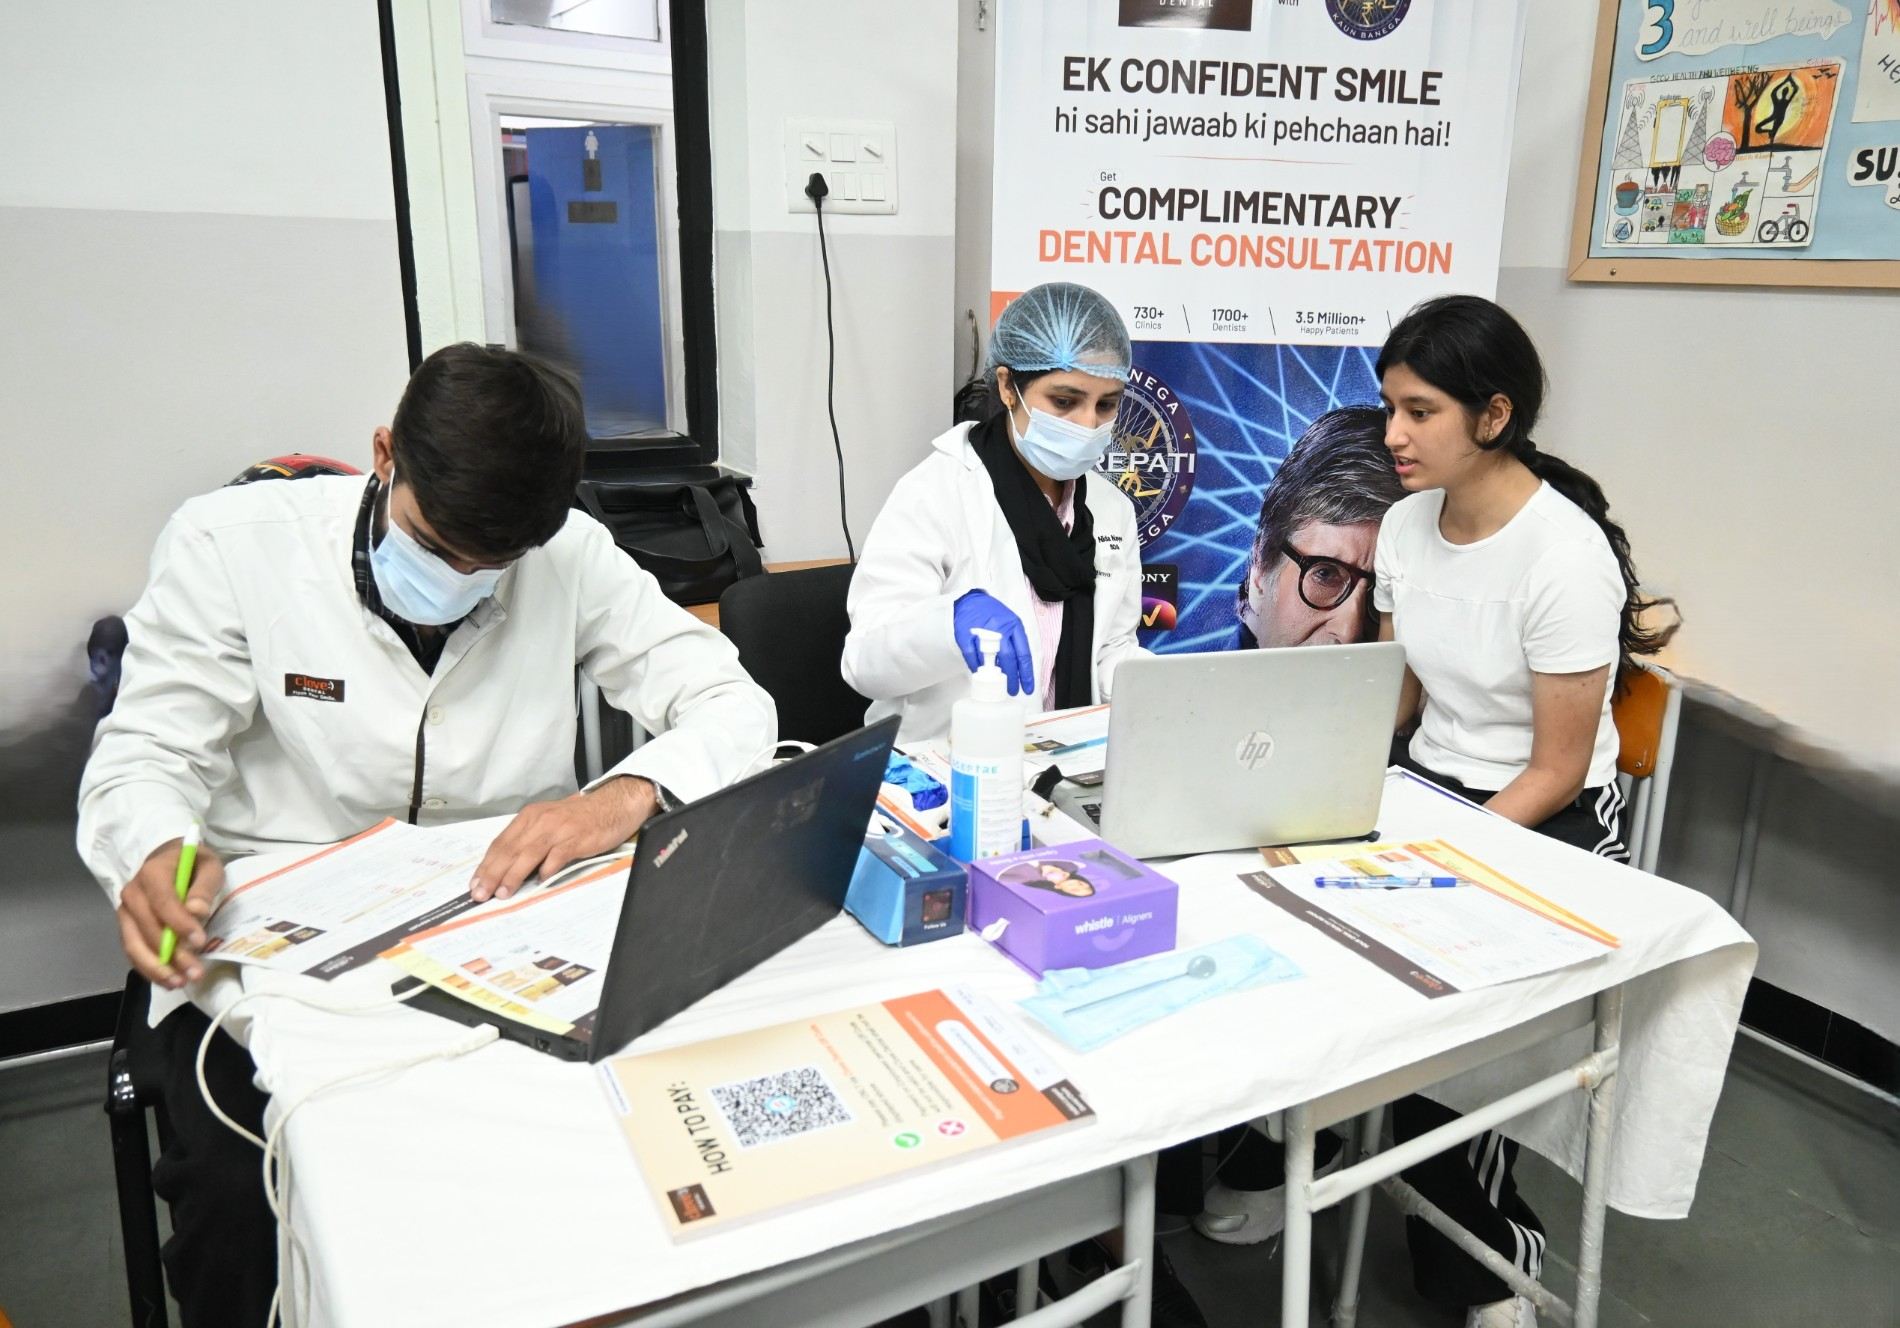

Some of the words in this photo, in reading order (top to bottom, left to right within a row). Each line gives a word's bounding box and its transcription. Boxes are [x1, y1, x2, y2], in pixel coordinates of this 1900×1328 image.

[1333, 13, 1356, 36] KAUN
[1361, 17, 1400, 39] BANEGA
[1063, 56, 1112, 92] EK
[1120, 58, 1327, 100] CONFIDENT
[1334, 67, 1443, 105] SMILE
[1055, 106, 1078, 133] hi
[1085, 108, 1139, 134] sahi
[1143, 109, 1237, 142] jawaab
[1244, 113, 1267, 139] ki
[1273, 116, 1398, 146] pehchaan
[1405, 120, 1451, 147] hai!
[1100, 172, 1117, 182] Get
[1854, 147, 1900, 182] SU
[1098, 186, 1402, 229] COMPLIMENTARY
[1039, 230, 1182, 265] DENTAL
[1190, 233, 1453, 274] CONSULTATION
[1133, 306, 1165, 320] 730+
[1135, 320, 1162, 330] Clinics
[1212, 308, 1249, 322] 1700+
[1295, 311, 1314, 324] 3.5
[1317, 312, 1366, 326] Million+
[1213, 322, 1247, 332] Dentists
[1300, 325, 1324, 336] Happy
[1326, 326, 1359, 336] Patients
[1130, 368, 1179, 416] NEGA
[1096, 452, 1196, 473] REPATI
[1239, 731, 1271, 770] hp
[1074, 916, 1114, 935] whistle
[1122, 911, 1152, 926] Aligners
[664, 1080, 699, 1113] PAY:
[681, 1113, 711, 1135] TO
[693, 1135, 732, 1175] HOW
